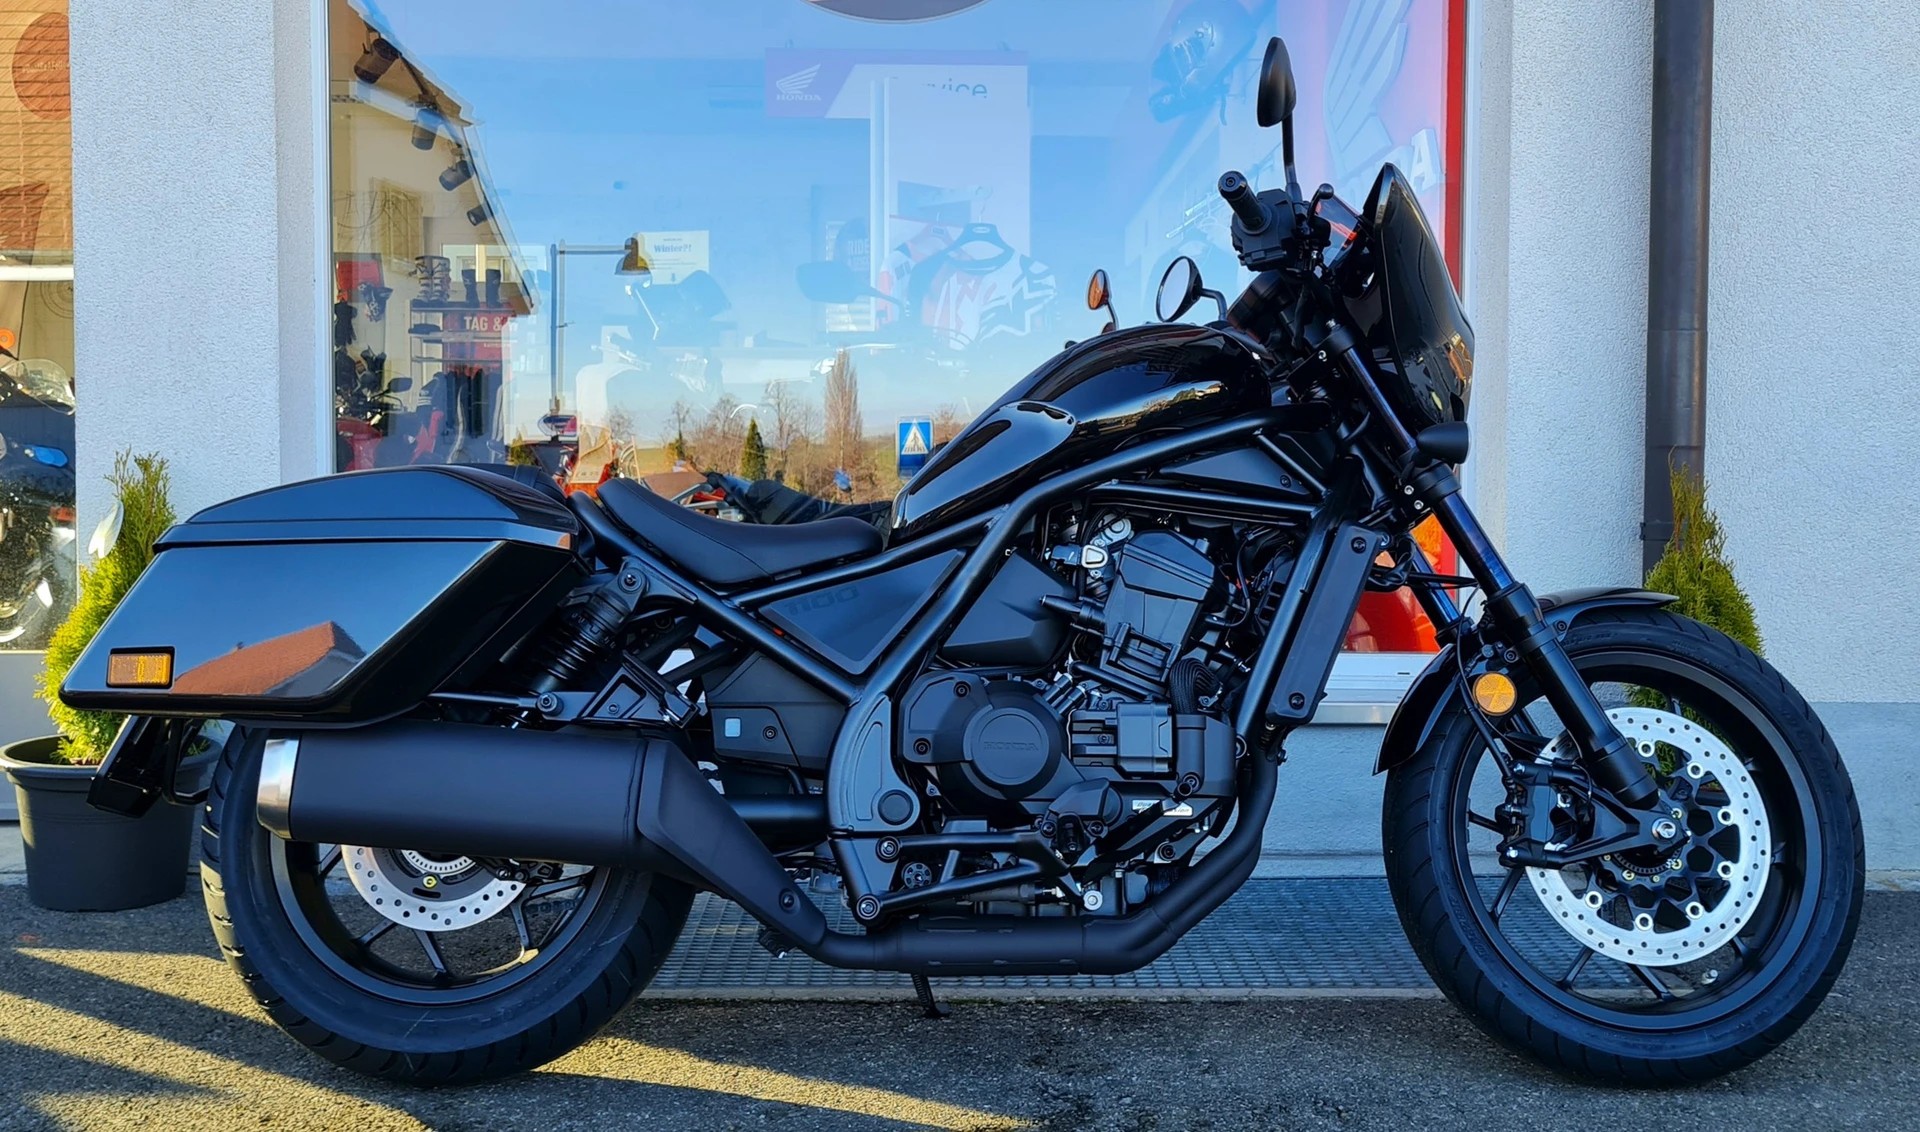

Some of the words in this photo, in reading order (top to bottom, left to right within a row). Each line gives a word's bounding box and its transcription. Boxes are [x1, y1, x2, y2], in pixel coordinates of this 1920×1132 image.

[776, 93, 822, 101] HONDA
[463, 316, 488, 331] TAG
[983, 741, 1040, 751] HONDA
